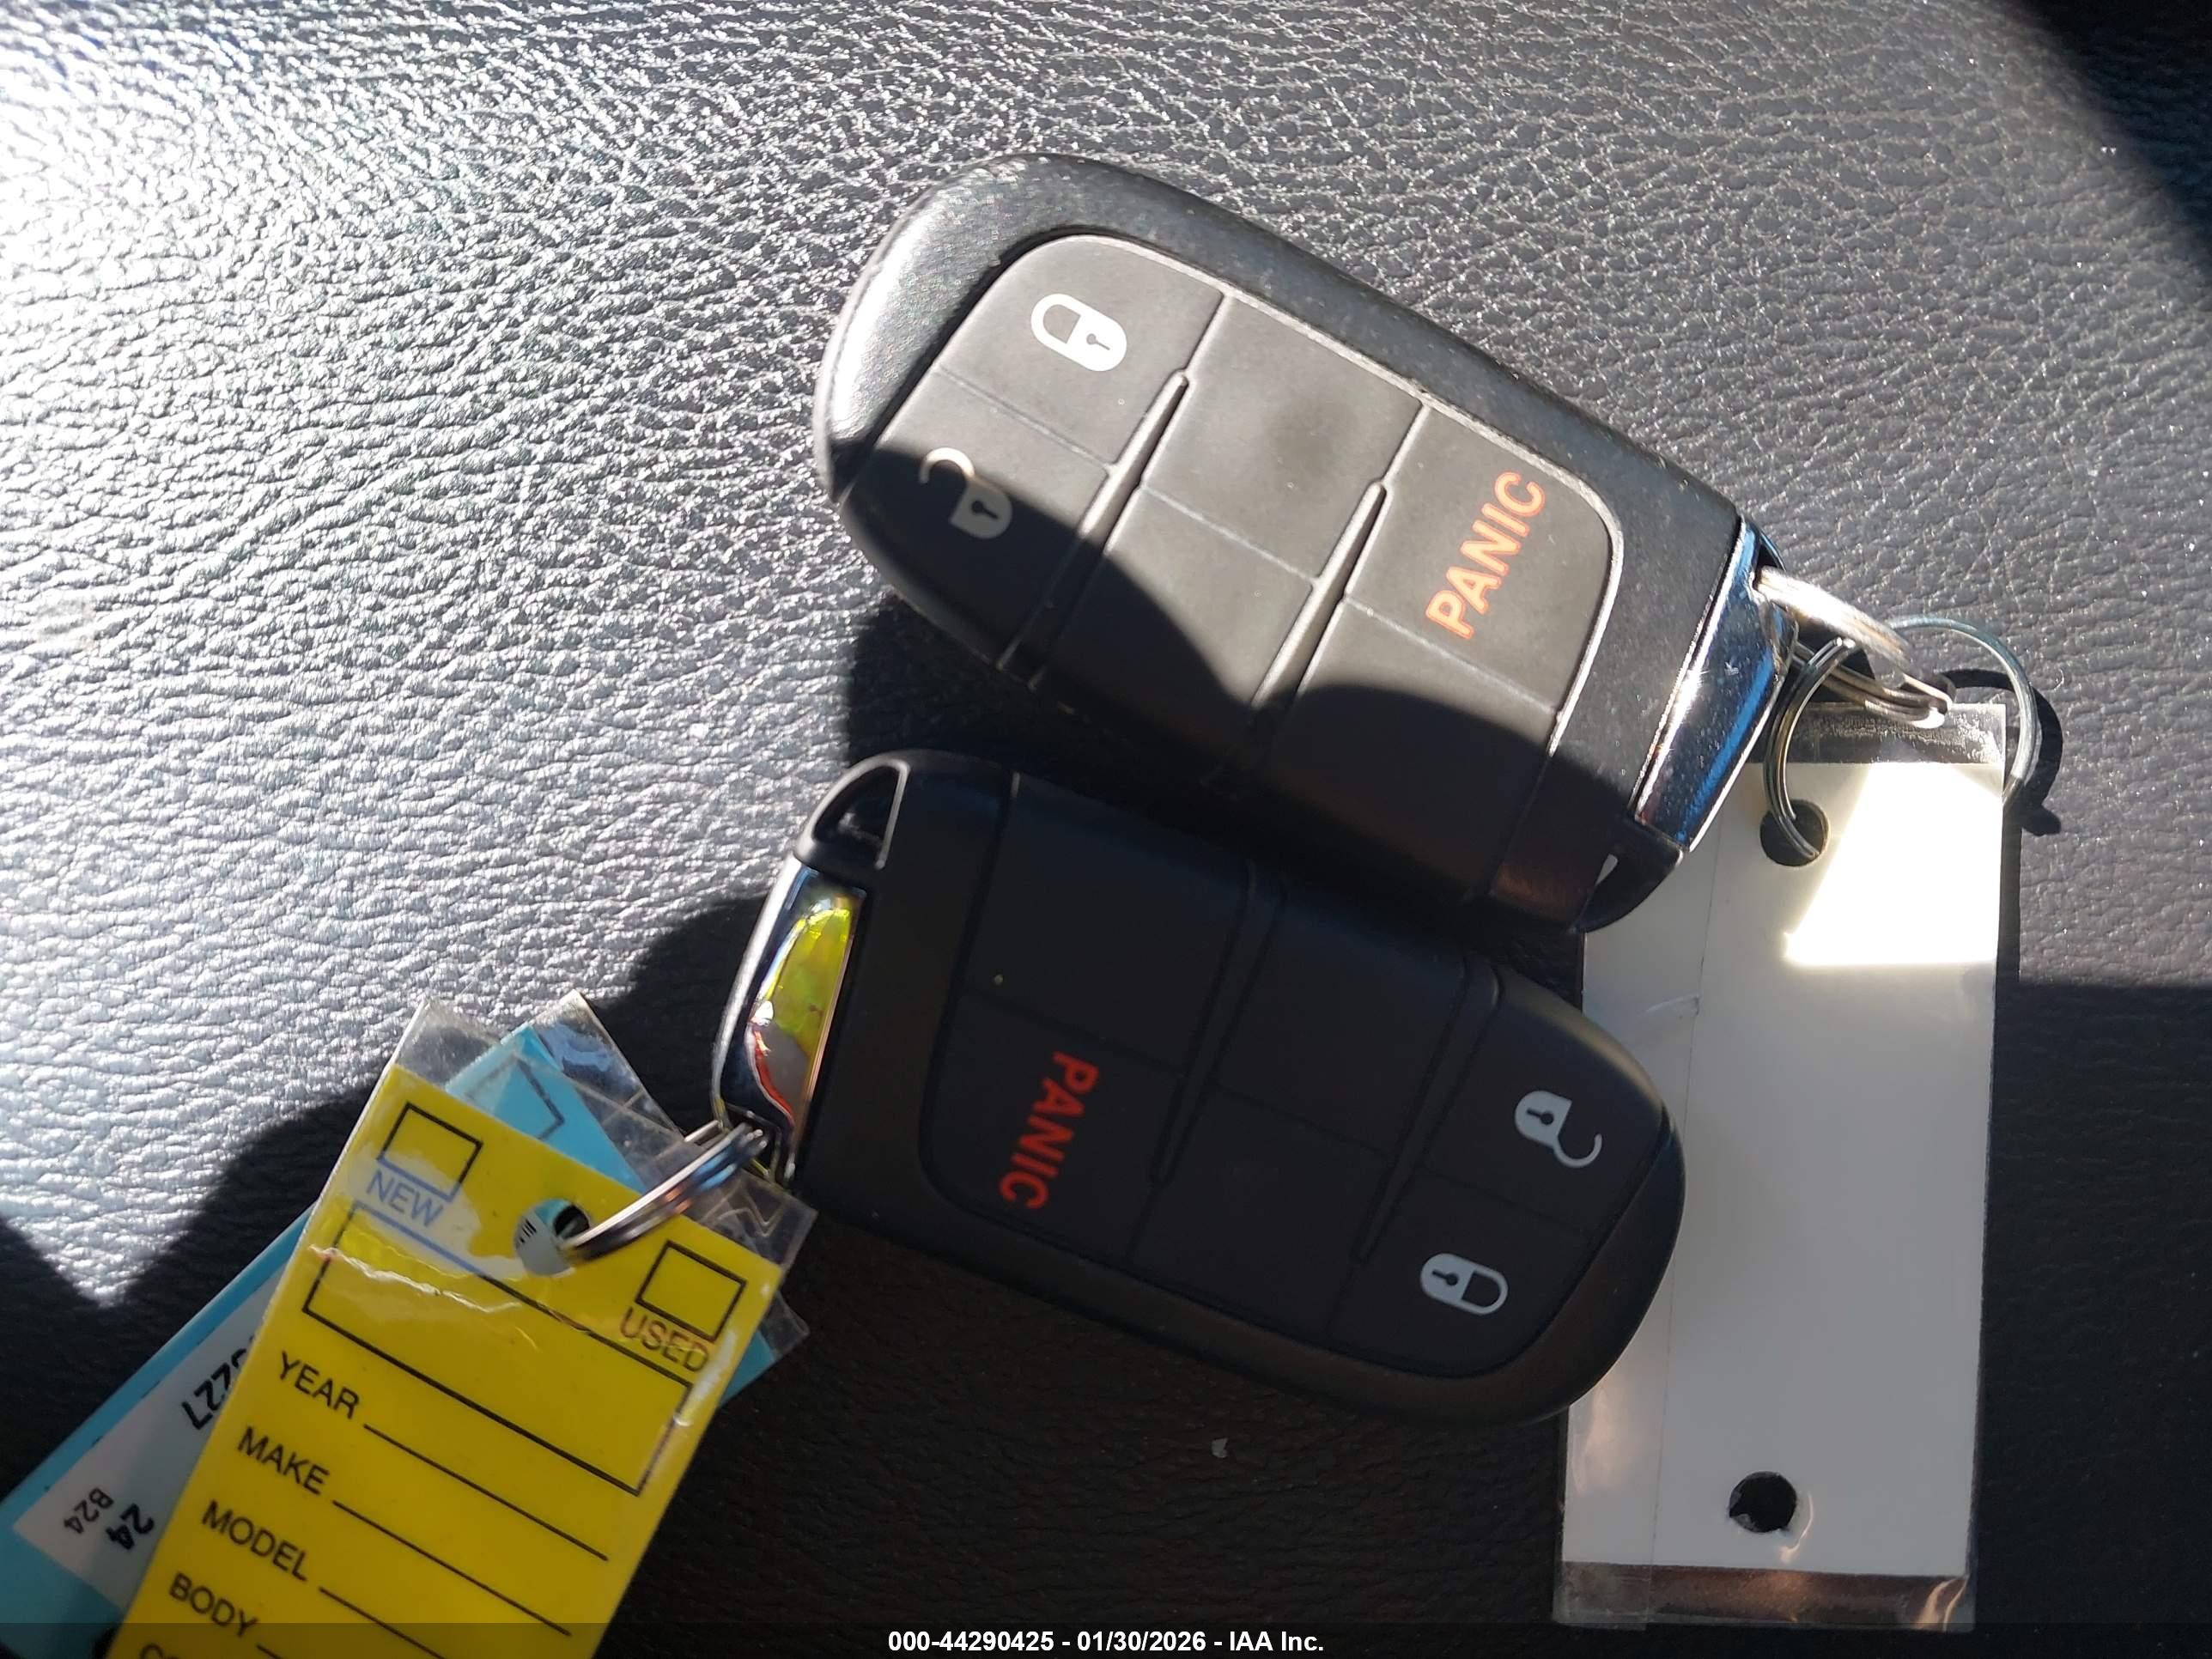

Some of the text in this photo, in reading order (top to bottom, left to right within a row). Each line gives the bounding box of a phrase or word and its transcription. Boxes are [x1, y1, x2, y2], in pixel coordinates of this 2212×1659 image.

[1425, 471, 1546, 639] PANIC
[999, 1051, 1099, 1209] PANIC
[366, 1169, 444, 1227] NEW
[620, 1306, 709, 1372] USED
[280, 1350, 360, 1420] YEAR
[237, 1425, 331, 1496] MAKE
[64, 1487, 115, 1534] B24
[105, 1504, 155, 1551] 24
[201, 1498, 308, 1583] MODEL
[168, 1571, 259, 1638] BODY
